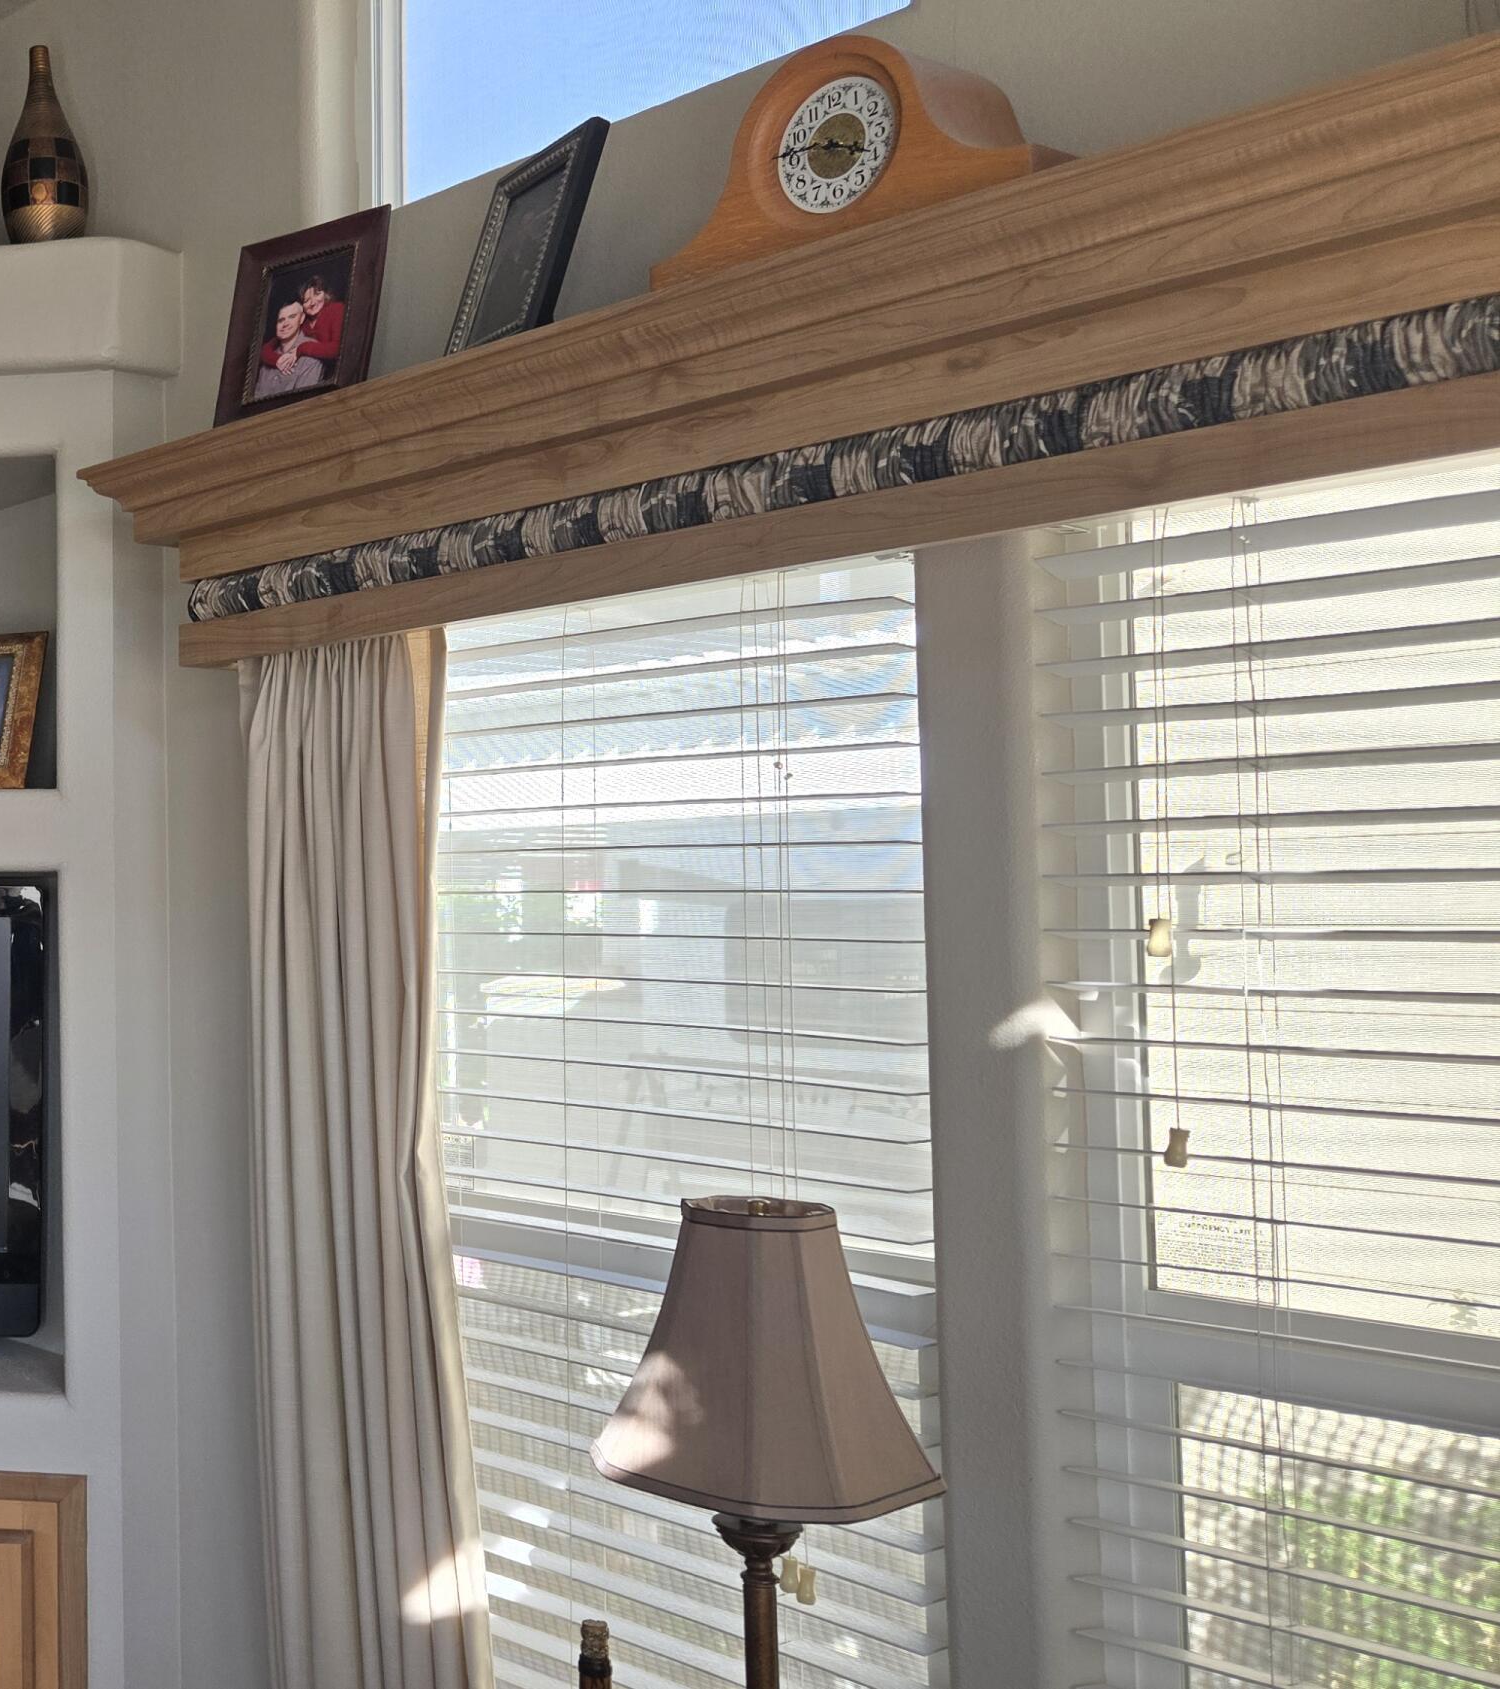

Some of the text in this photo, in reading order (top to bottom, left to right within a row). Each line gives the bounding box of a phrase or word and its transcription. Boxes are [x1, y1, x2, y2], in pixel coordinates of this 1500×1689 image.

[826, 91, 842, 109] 12
[854, 91, 859, 105] 1
[809, 107, 819, 123] 11
[866, 101, 879, 117] 2
[792, 129, 807, 146] 10
[874, 122, 885, 138] 3
[788, 150, 801, 169] 9
[867, 146, 880, 162] 4
[795, 175, 806, 189] 8
[854, 170, 865, 186] 5
[812, 185, 822, 201] 7
[832, 184, 844, 199] 6
